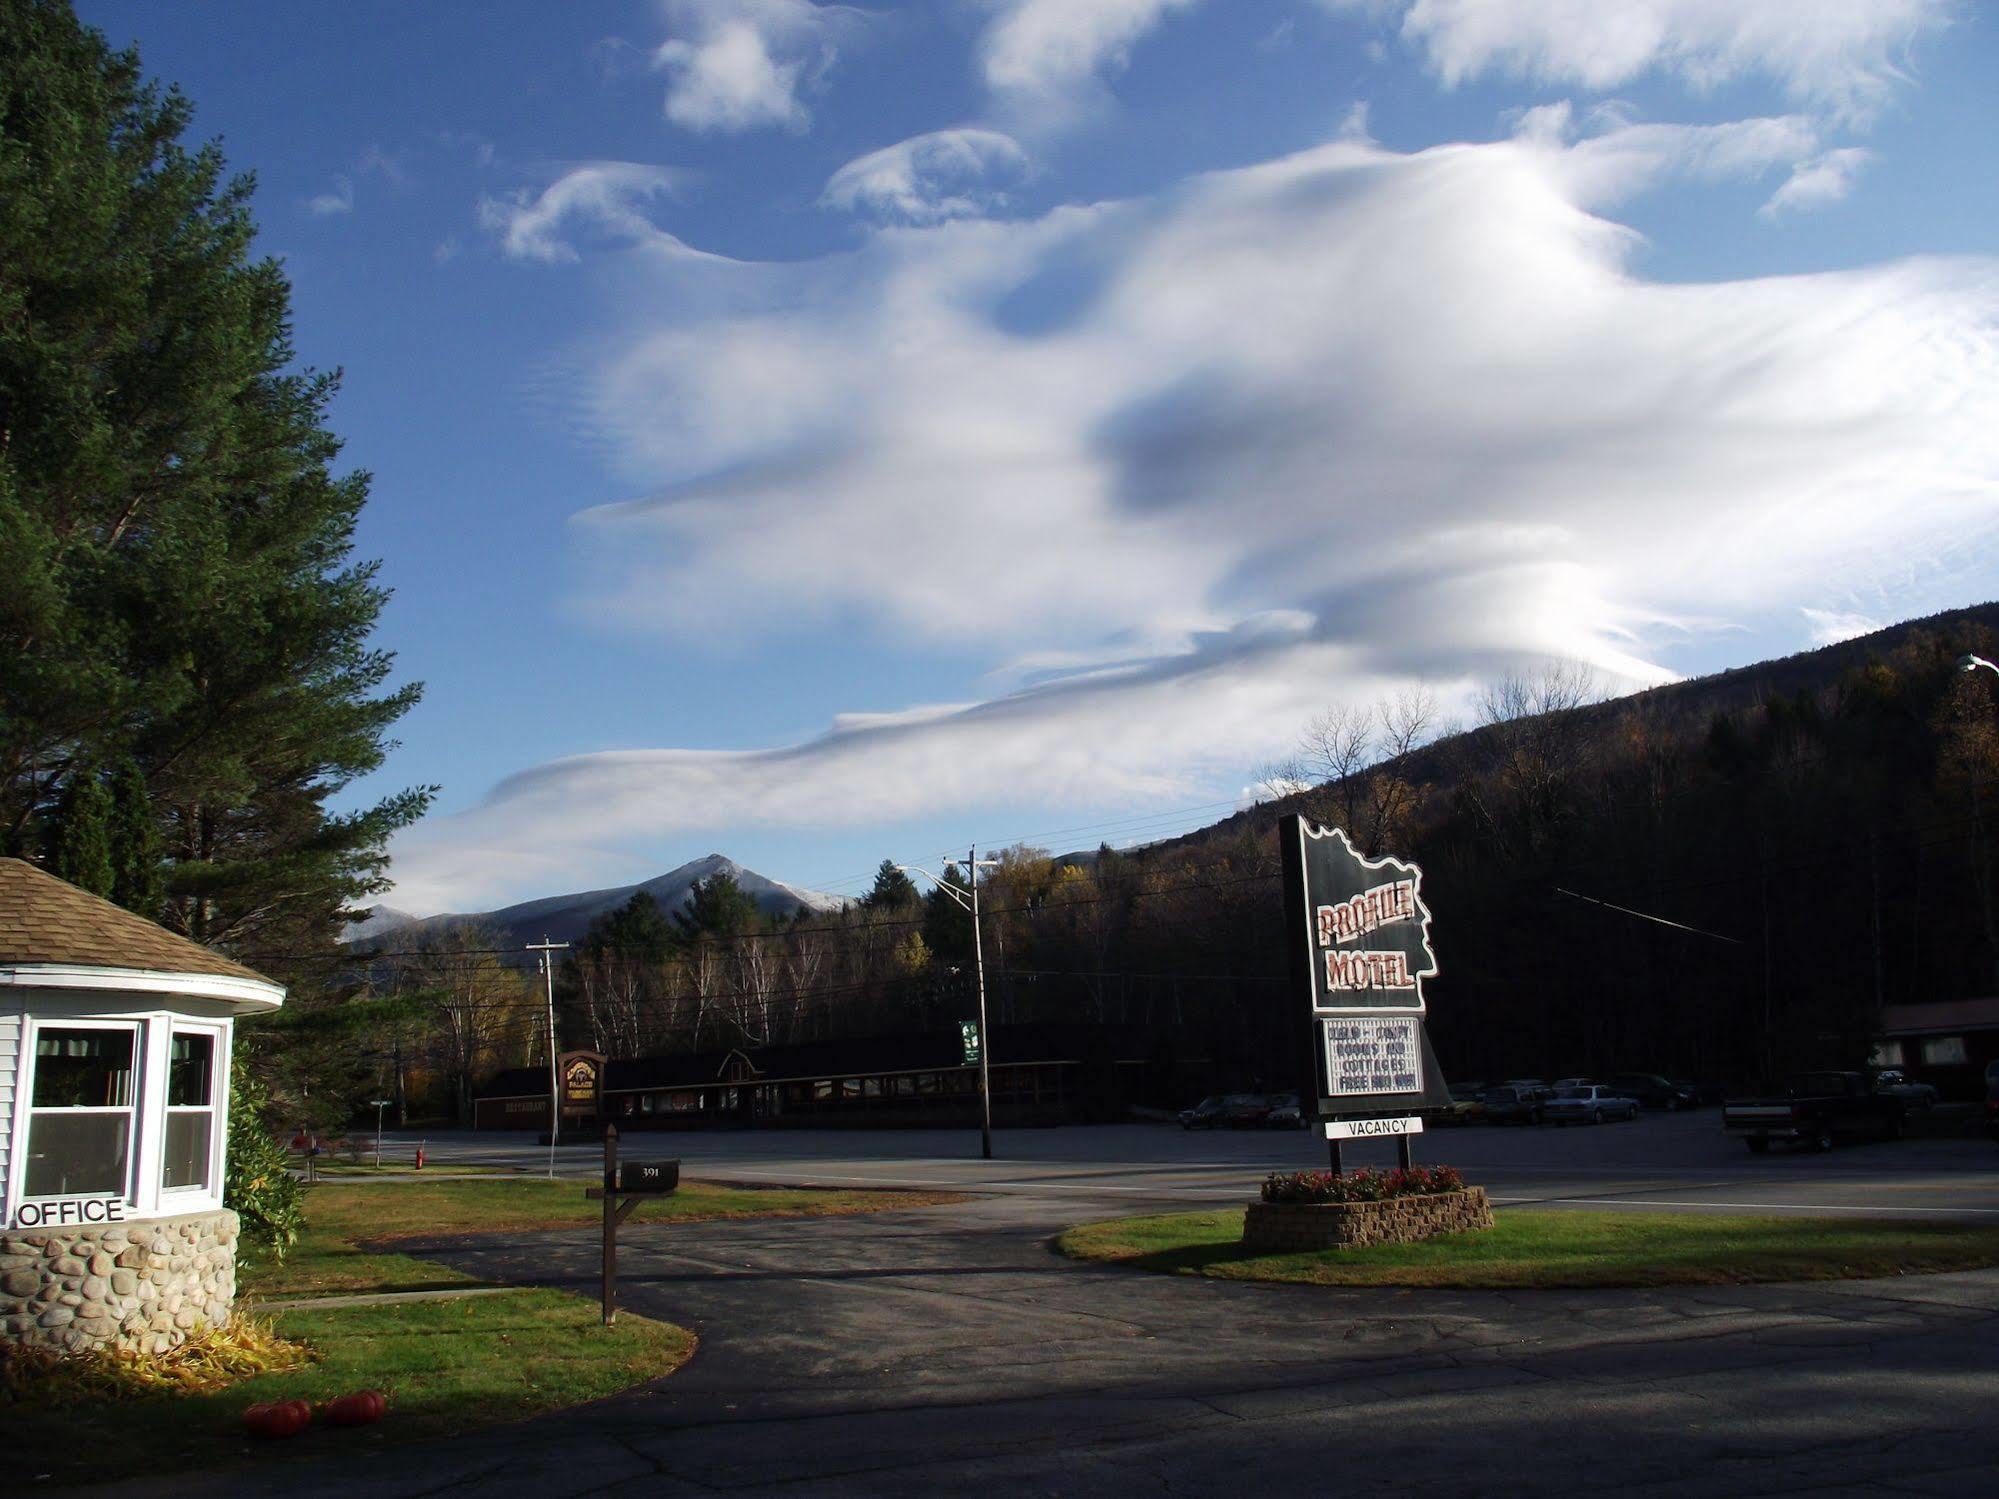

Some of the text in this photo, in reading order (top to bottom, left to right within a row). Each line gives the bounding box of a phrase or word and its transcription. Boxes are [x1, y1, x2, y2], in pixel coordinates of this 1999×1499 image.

[1317, 879, 1415, 947] PROFILE
[1325, 950, 1417, 992] MOTEL
[1343, 1059, 1406, 1072] COTTAGES
[1340, 1075, 1368, 1089] FREE
[1349, 1120, 1408, 1135] VACANCY
[642, 1167, 660, 1177] 391
[18, 1199, 125, 1226] OFFICE
